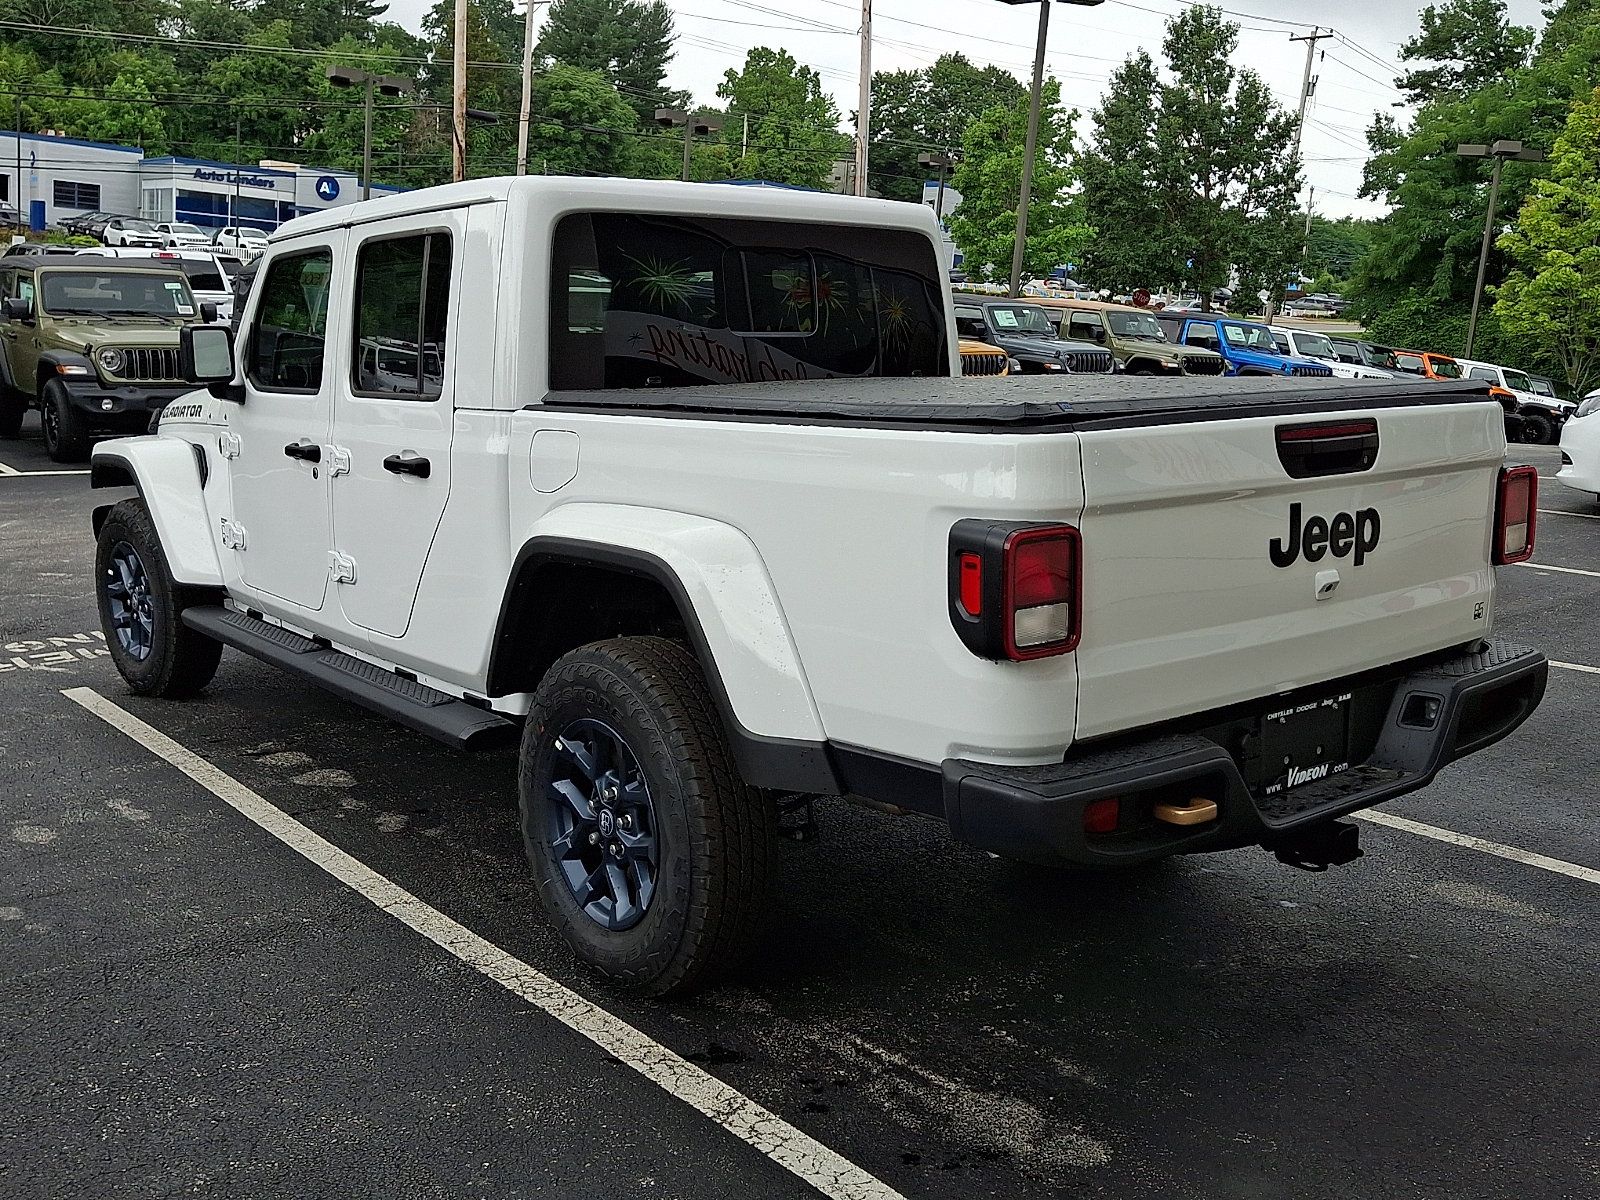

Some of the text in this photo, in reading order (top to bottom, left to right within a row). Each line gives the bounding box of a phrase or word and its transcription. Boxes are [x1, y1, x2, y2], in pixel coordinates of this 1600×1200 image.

[194, 168, 275, 189] Auto Lenders
[1133, 292, 1149, 303] STOP
[1269, 502, 1381, 568] Jeep
[1267, 693, 1352, 721] CHRYSLER DODGE Jeep RAM
[1287, 763, 1329, 788] VIDEON
